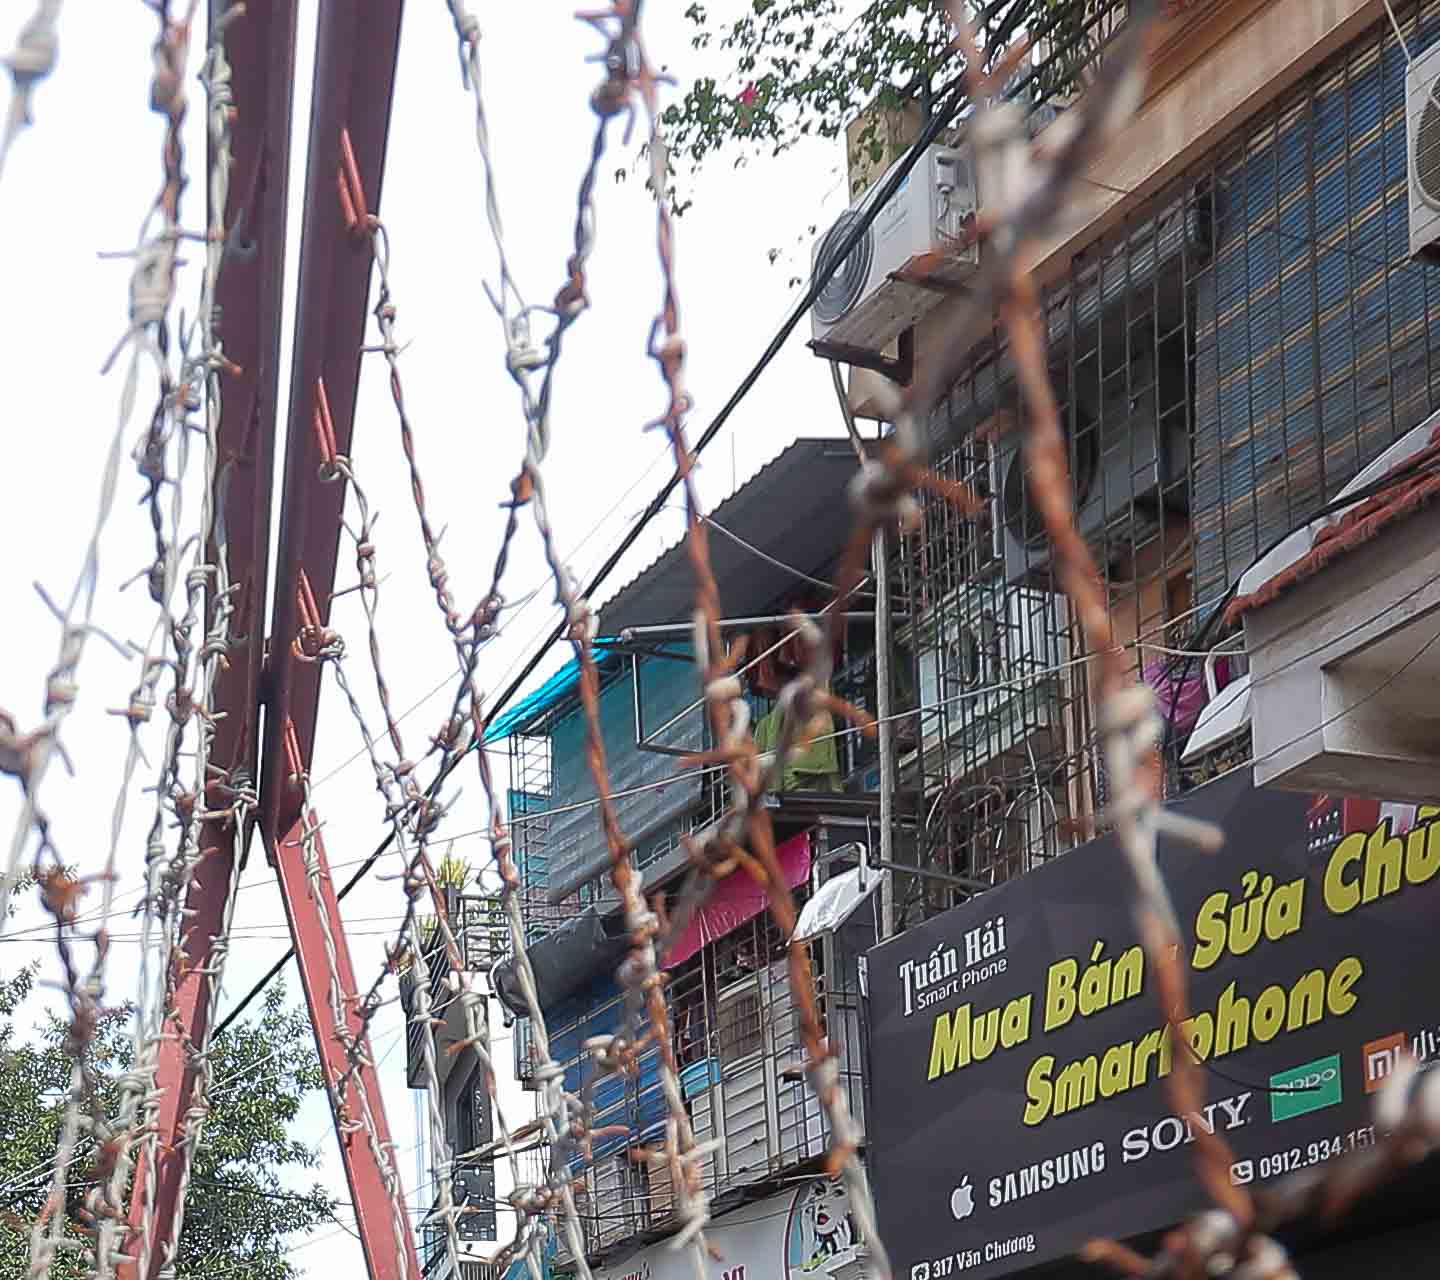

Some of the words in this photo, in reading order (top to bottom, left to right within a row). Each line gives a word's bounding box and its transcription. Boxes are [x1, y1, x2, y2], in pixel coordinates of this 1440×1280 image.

[899, 942, 958, 1017] Tuấn
[965, 916, 1007, 967] Hải
[917, 980, 959, 1010] Smart
[962, 958, 1008, 990] Phone
[928, 993, 1033, 1081] Mua
[1044, 940, 1144, 1032] Bán
[1191, 871, 1305, 970] Sửa
[1121, 1092, 1253, 1164] SONY
[987, 1141, 1106, 1208] SAMSUNG
[931, 1255, 953, 1279] 317
[956, 1245, 981, 1269] Văn
[985, 1233, 1036, 1263] Chương
